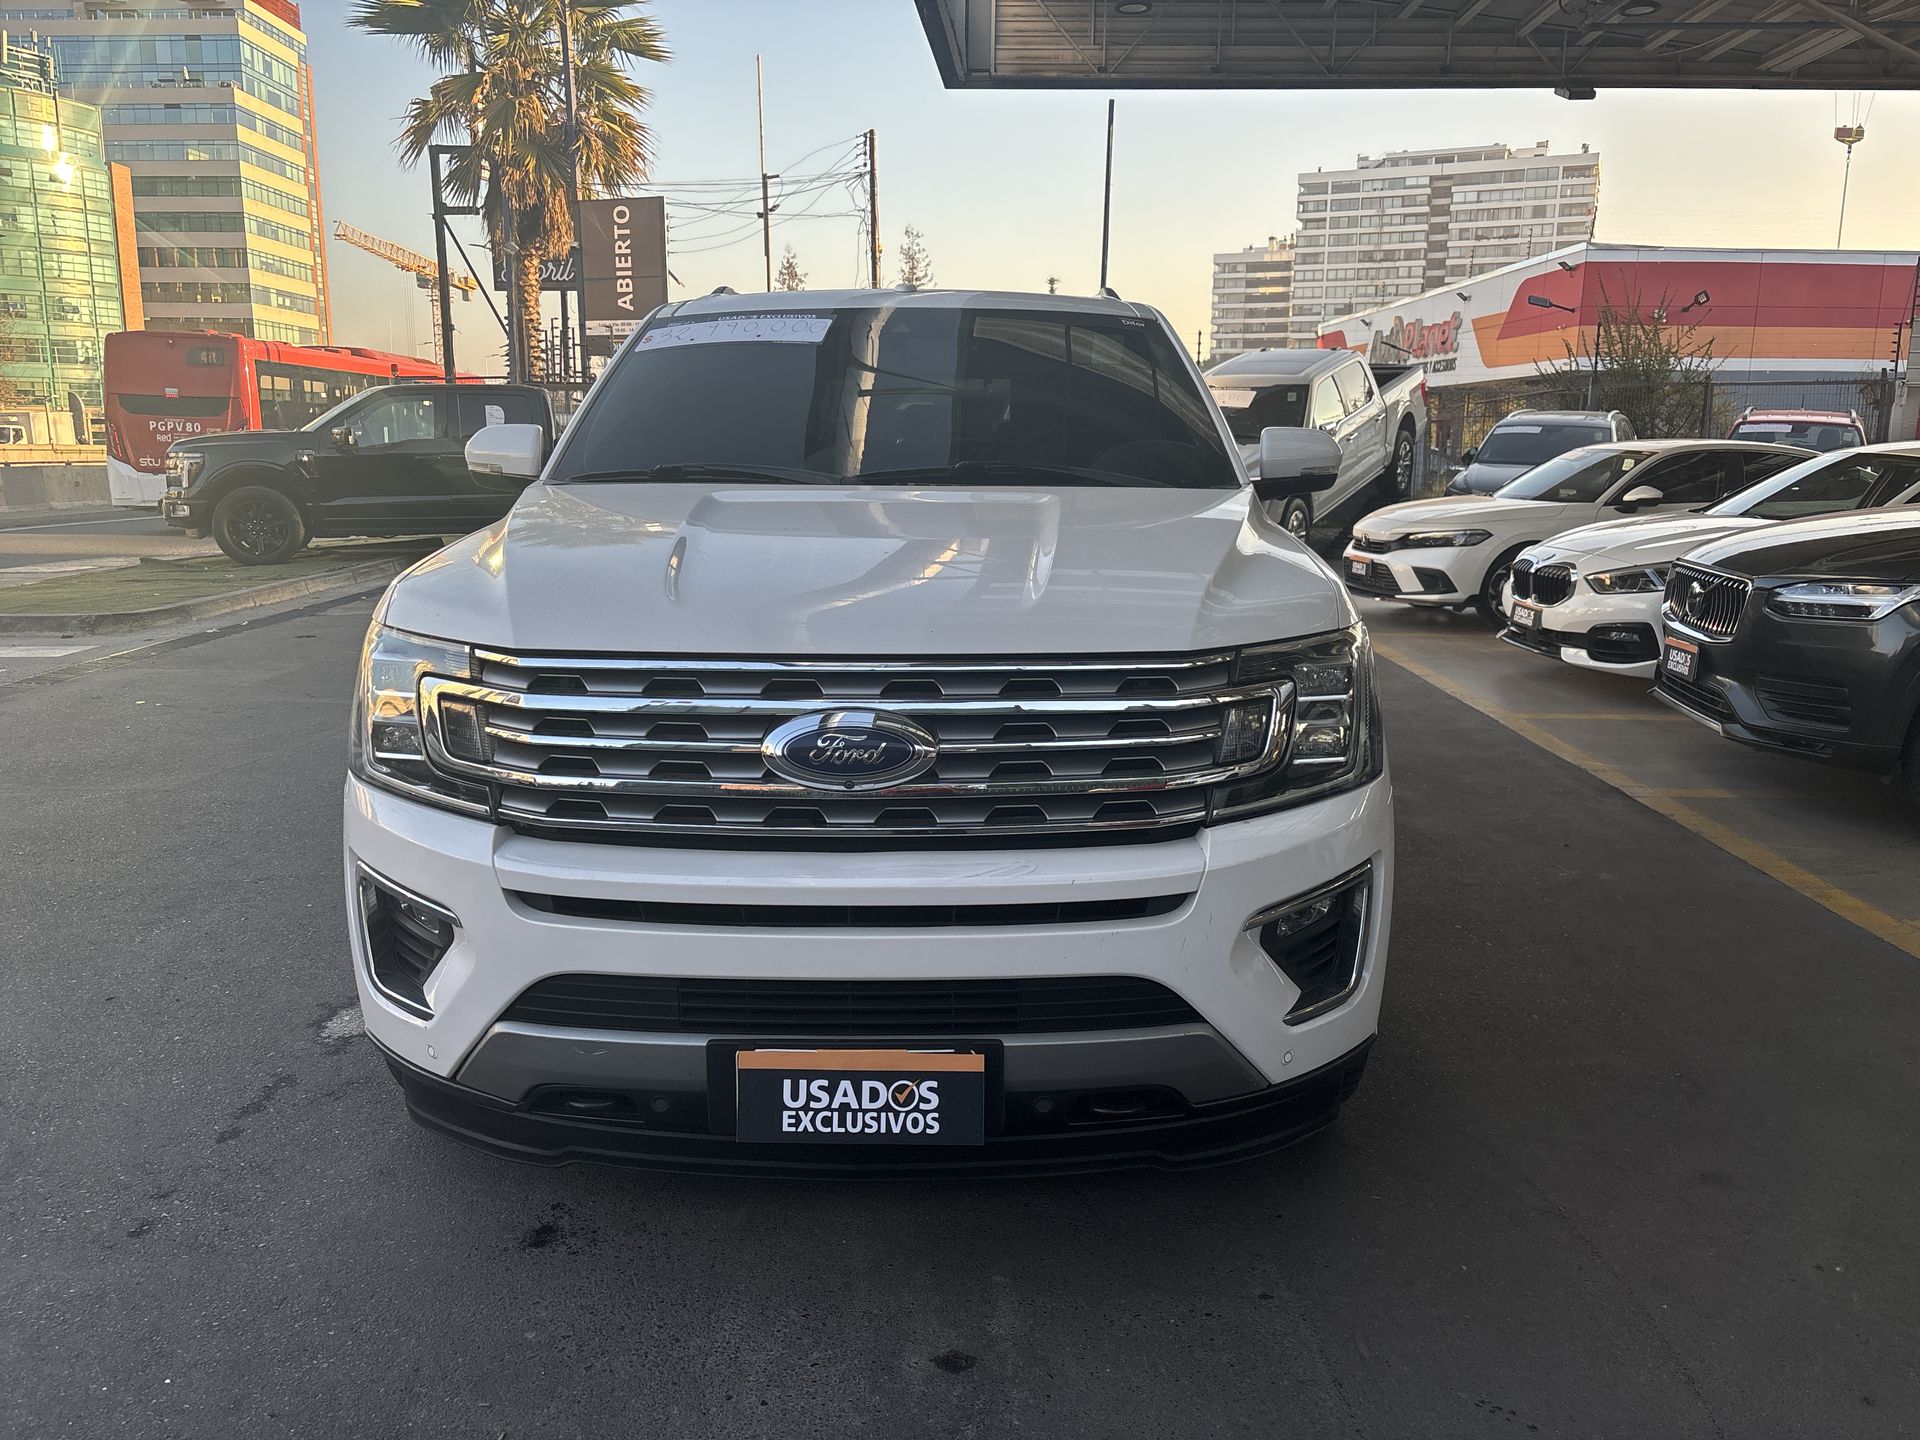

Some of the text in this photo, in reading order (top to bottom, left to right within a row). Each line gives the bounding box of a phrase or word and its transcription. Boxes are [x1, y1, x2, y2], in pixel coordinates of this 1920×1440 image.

[612, 205, 634, 311] ABIERTO
[156, 433, 172, 442] Red
[1669, 648, 1691, 666] USADOS
[809, 733, 888, 765] Ford
[782, 1078, 940, 1112] USADOS
[782, 1110, 940, 1135] EXCLUSIVOS
